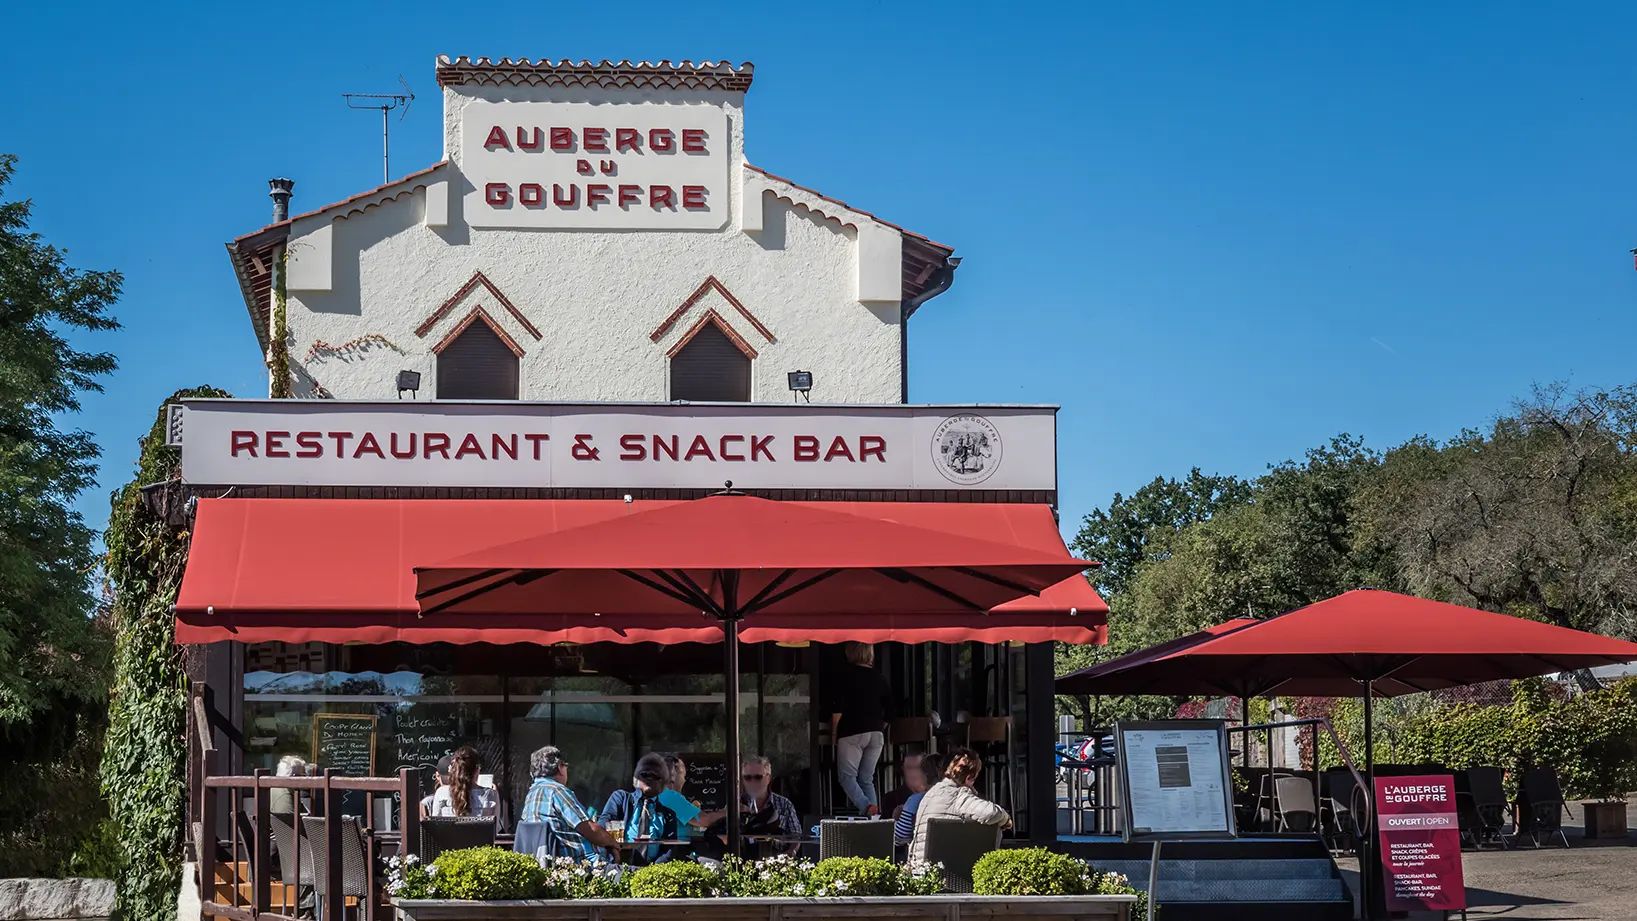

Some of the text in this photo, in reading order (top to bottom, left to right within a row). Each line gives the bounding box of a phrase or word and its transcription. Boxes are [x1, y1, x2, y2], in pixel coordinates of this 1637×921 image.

[484, 125, 706, 152] AUBERGE
[576, 159, 614, 173] DU
[485, 182, 706, 208] GOUFFRE
[231, 430, 887, 463] RESTAURANT & SNACK BAR
[1384, 786, 1446, 794] L'AUBERGE
[1394, 794, 1447, 802] GOUFFRE
